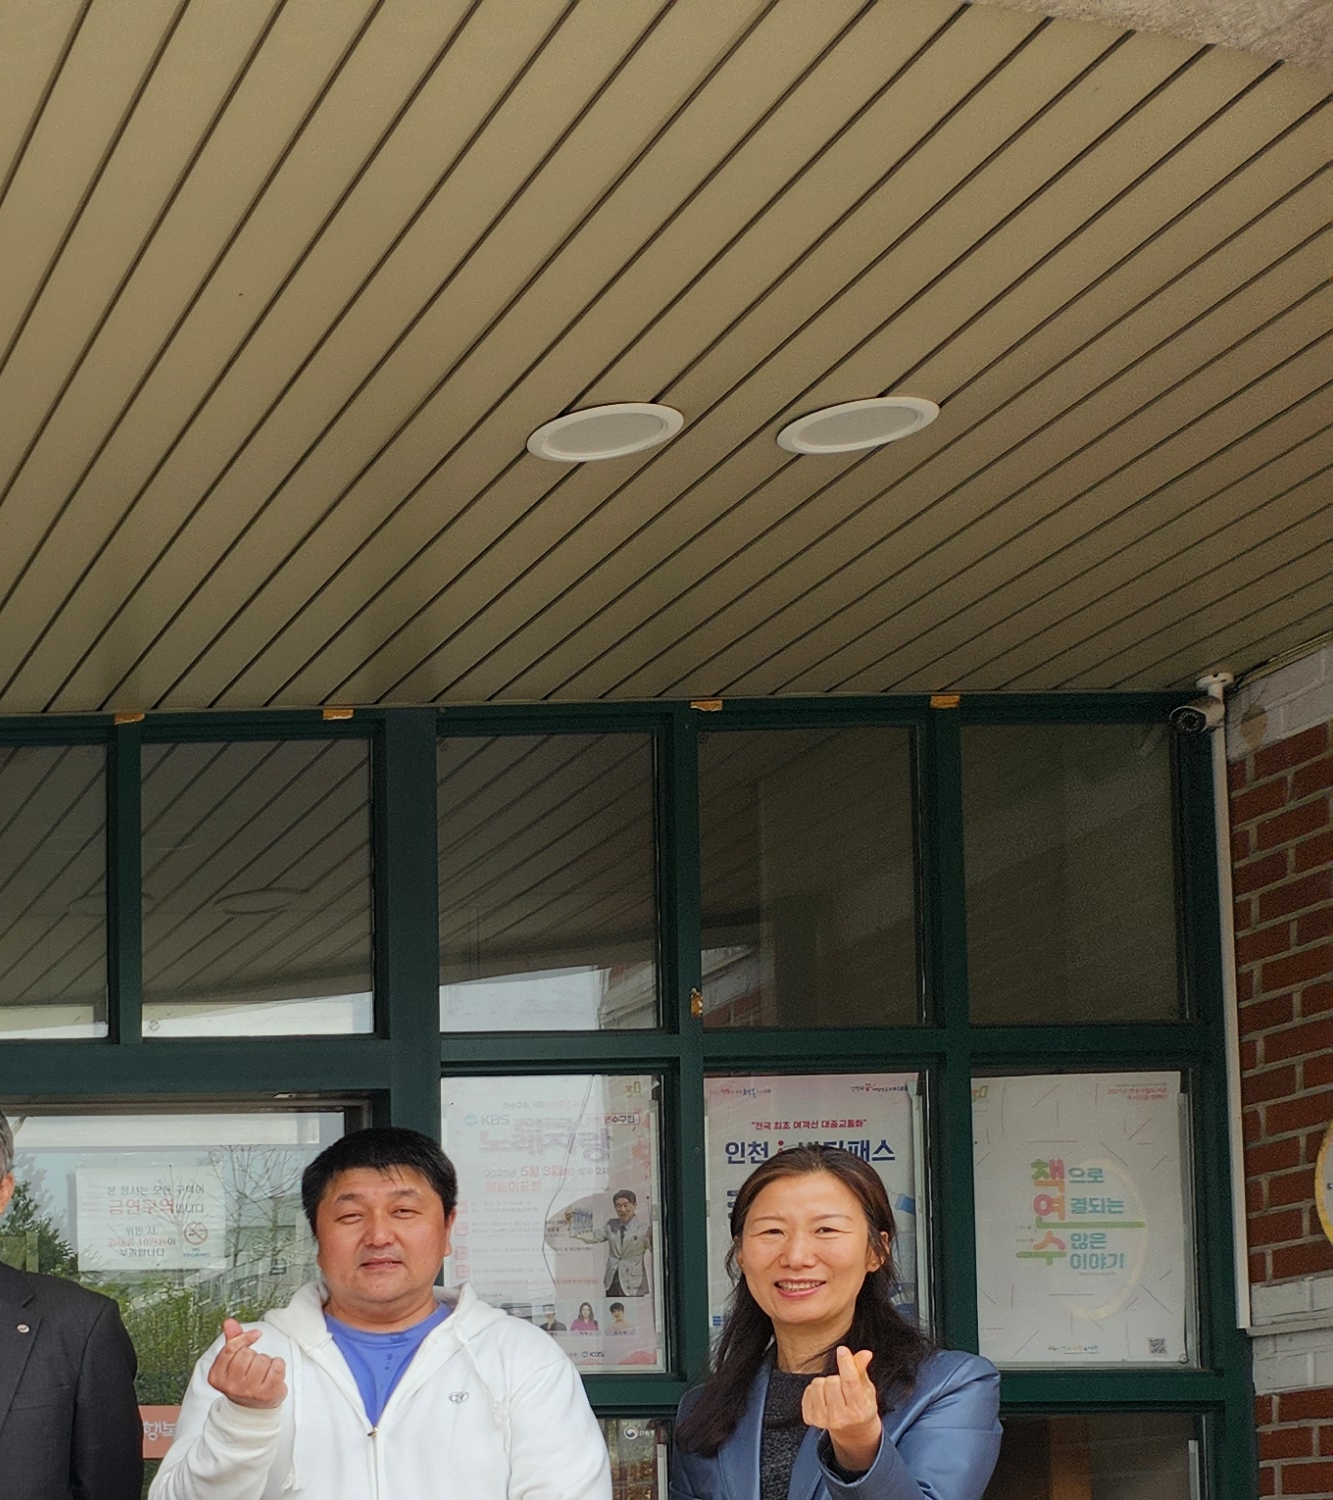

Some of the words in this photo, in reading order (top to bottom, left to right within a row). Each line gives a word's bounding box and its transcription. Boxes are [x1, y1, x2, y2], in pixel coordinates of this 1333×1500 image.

[481, 1115, 510, 1126] KBS
[774, 1121, 791, 1130] 최초
[793, 1120, 819, 1130] 여객선
[725, 1140, 769, 1165] 인천
[1070, 1253, 1124, 1270] 이야기
